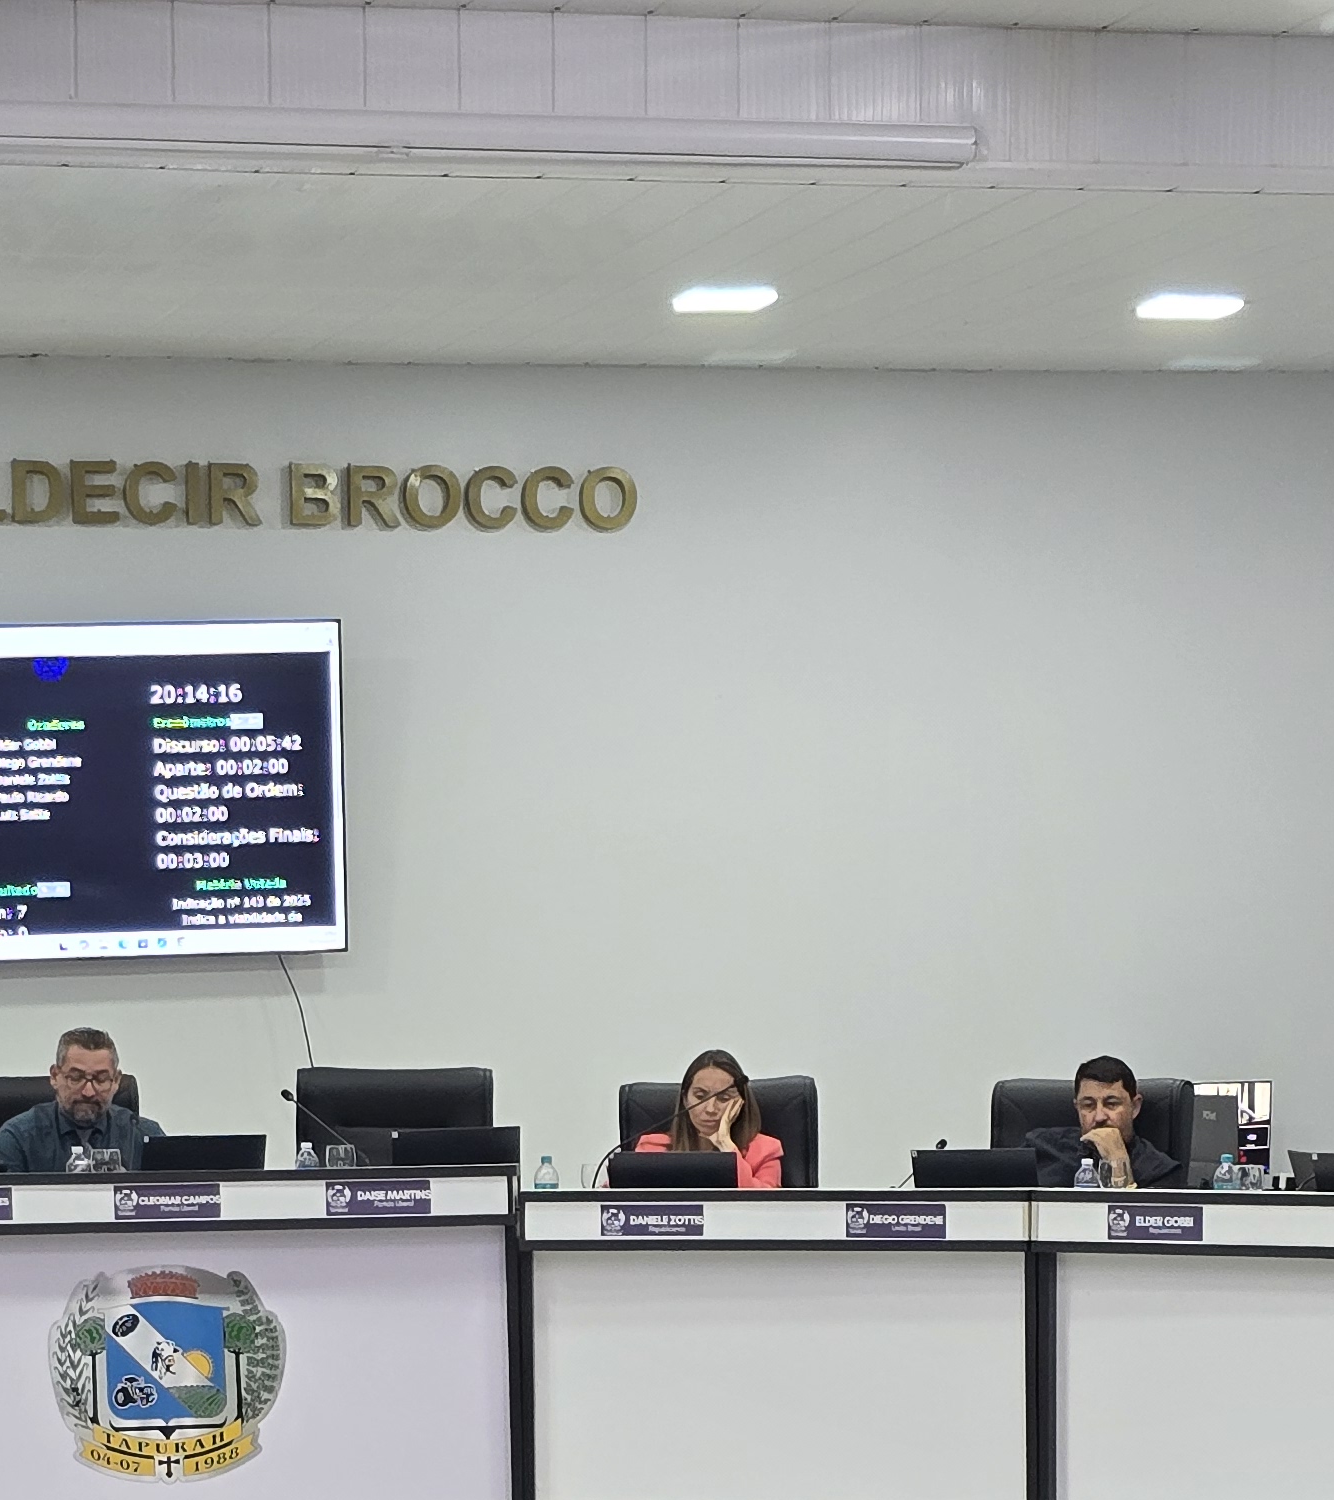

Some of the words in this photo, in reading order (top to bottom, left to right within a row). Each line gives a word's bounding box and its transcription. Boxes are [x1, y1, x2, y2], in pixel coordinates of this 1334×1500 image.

[289, 462, 638, 531] BROCCO
[149, 683, 243, 704] 20:14:16
[153, 737, 226, 753] Discurso:
[229, 734, 303, 752] 00:05:42
[153, 760, 213, 778] Aparte:
[216, 757, 289, 775] 00:02:00
[154, 782, 219, 803] Questão
[222, 783, 243, 798] de
[245, 782, 305, 798] Ordem:
[155, 805, 229, 823] 00:02:00
[155, 828, 267, 847] Considerações
[269, 827, 321, 843] Finais:
[156, 851, 230, 869] 00:03:00
[266, 895, 282, 907] de
[283, 894, 312, 907] 2025
[16, 904, 28, 920] 7
[182, 1194, 222, 1205] CAMPOS
[357, 1190, 386, 1201] DAISE
[387, 1189, 432, 1200] MARTINS
[629, 1215, 669, 1226] DANIELE
[669, 1215, 705, 1226] ZOTTIS
[869, 1214, 898, 1224] DIEGO
[1135, 1215, 1164, 1227] ELDER
[1164, 1216, 1194, 1227] GOBBI
[101, 1431, 226, 1454] TAPURAH
[90, 1448, 142, 1473] 04-07
[193, 1446, 241, 1473] 1988
